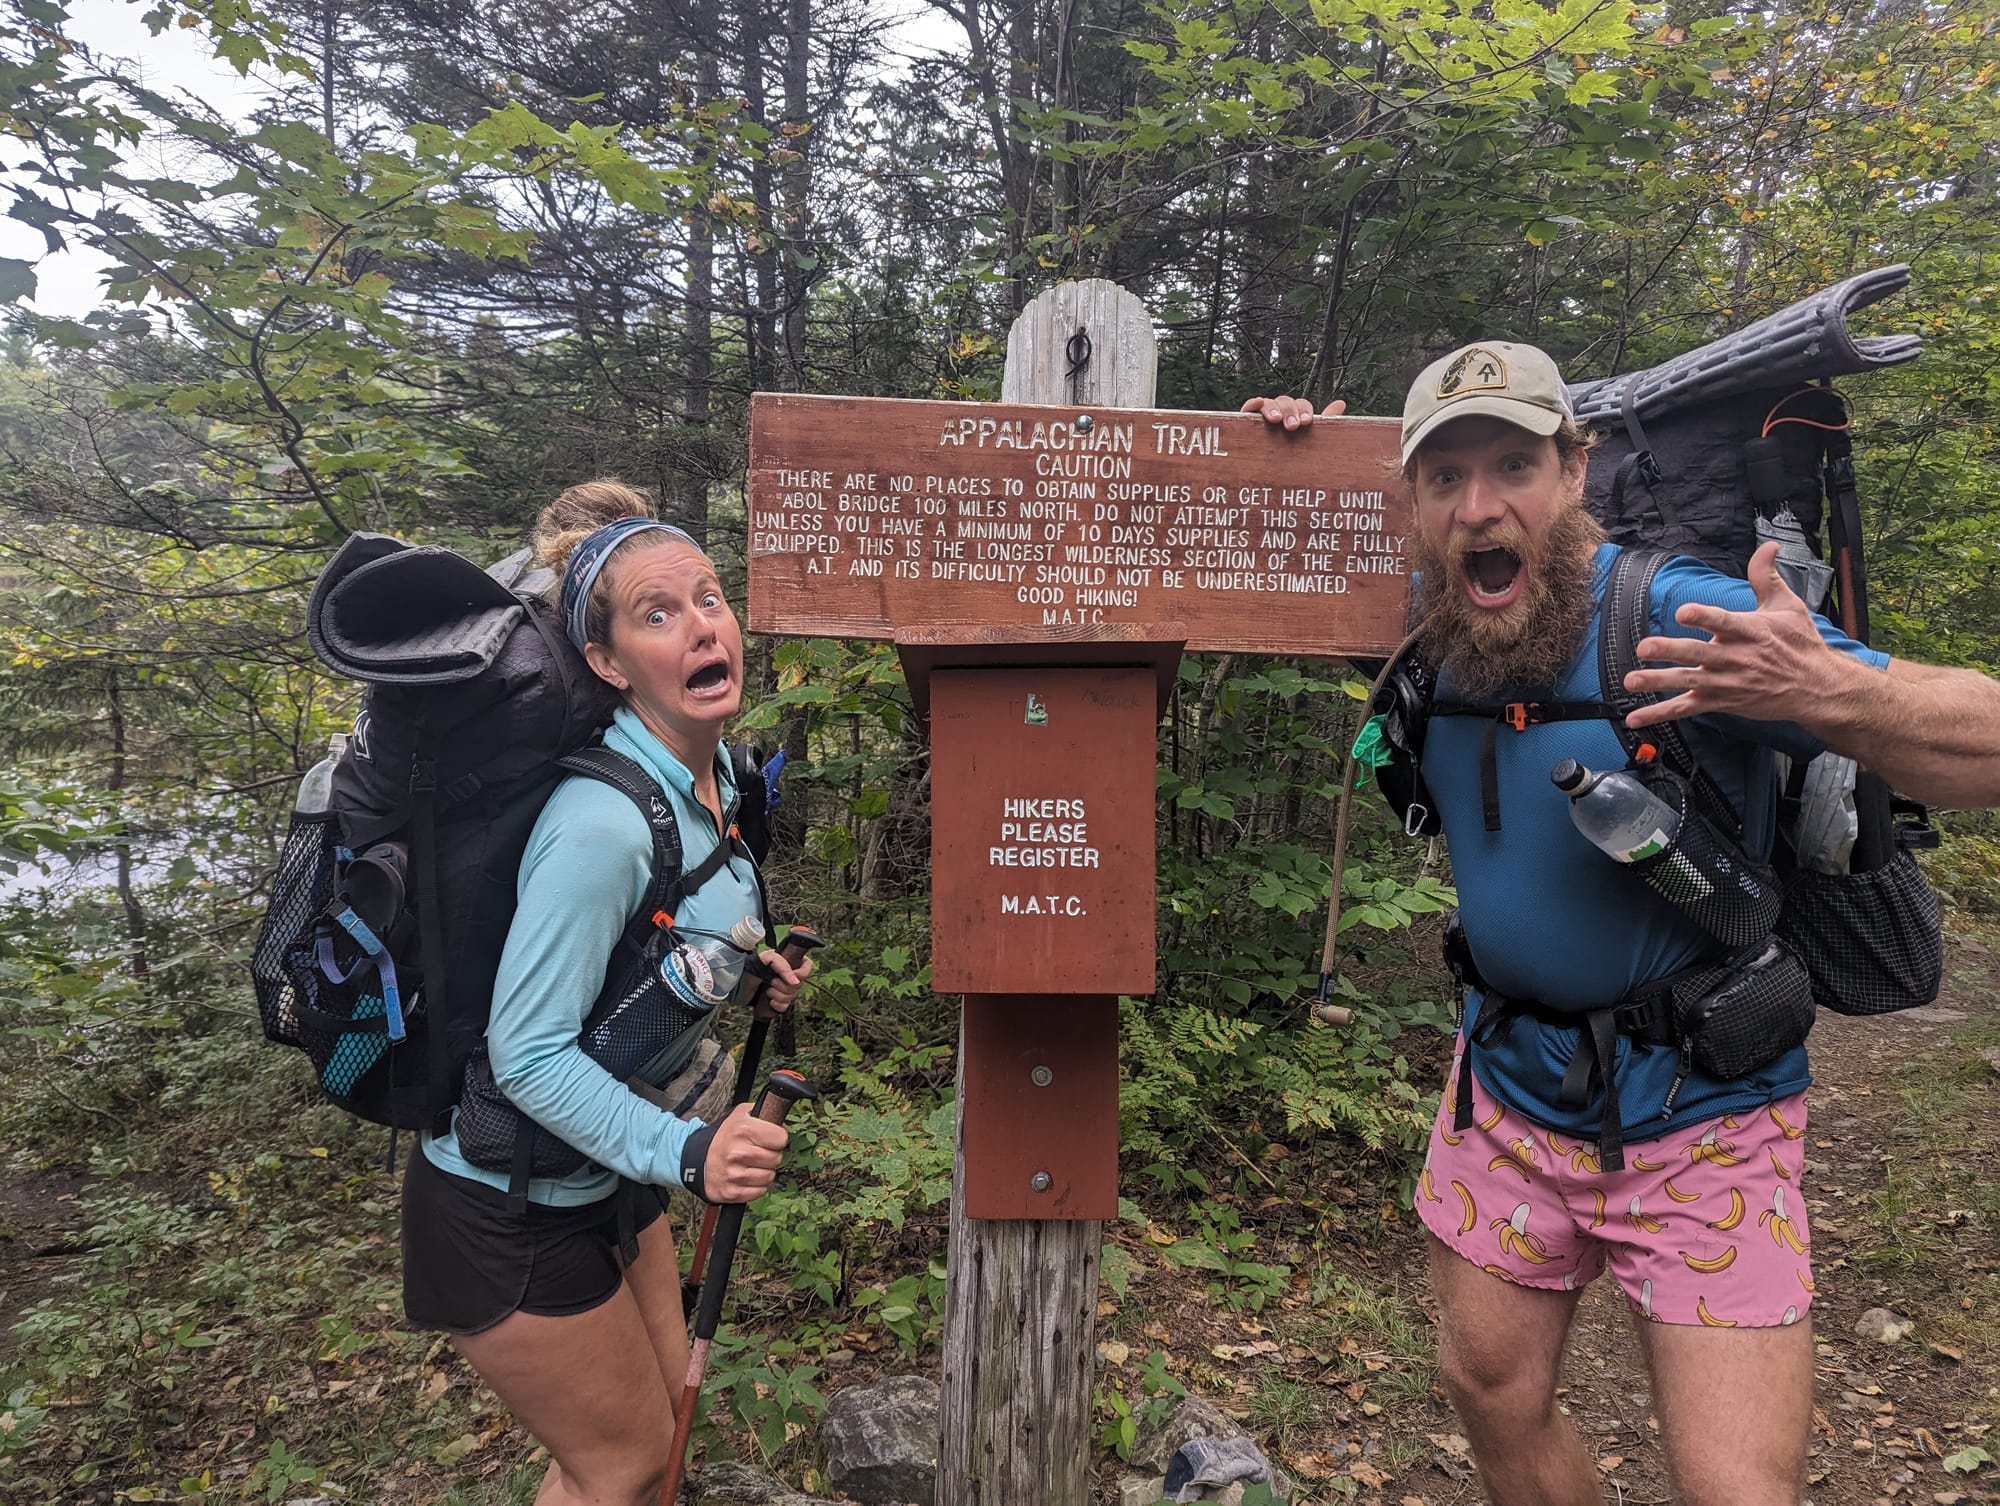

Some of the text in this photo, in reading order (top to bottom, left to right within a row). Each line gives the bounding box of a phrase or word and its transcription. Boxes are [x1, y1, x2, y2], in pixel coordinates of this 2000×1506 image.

[940, 416, 1228, 456] APPALACHIAN TRAIL
[1036, 453, 1131, 478] CAUTION
[778, 470, 1386, 510] THERE ARE NO PLACES TO OBTAIN SUPPLIES OR GET HELP UNTIL
[782, 493, 1382, 531] ABOL BRIDGE 100 MILES NORTH. DO NOT ATTEMPT THIS SECTION
[756, 512, 1405, 553] UNLESS YOU HAVE A MINIMUM OF 10 DAYS SUPPLIES AND ARE FULLY
[754, 533, 1405, 575] EQUIPPED. THIS IS THE LONGEST WILDERNESS SECTION OF THE ENTIRE
[807, 557, 1351, 594] A.T. AND ITS DIFFICULTY SHOULD NOT BE UNDERESTIMATED.
[1018, 586, 1137, 607] GOOD HIKING!
[1004, 798, 1085, 819] HIKERS
[1002, 823, 1087, 843] PLEASE
[989, 847, 1099, 868] REGISTER
[1001, 895, 1087, 916] M.A.T.C.
